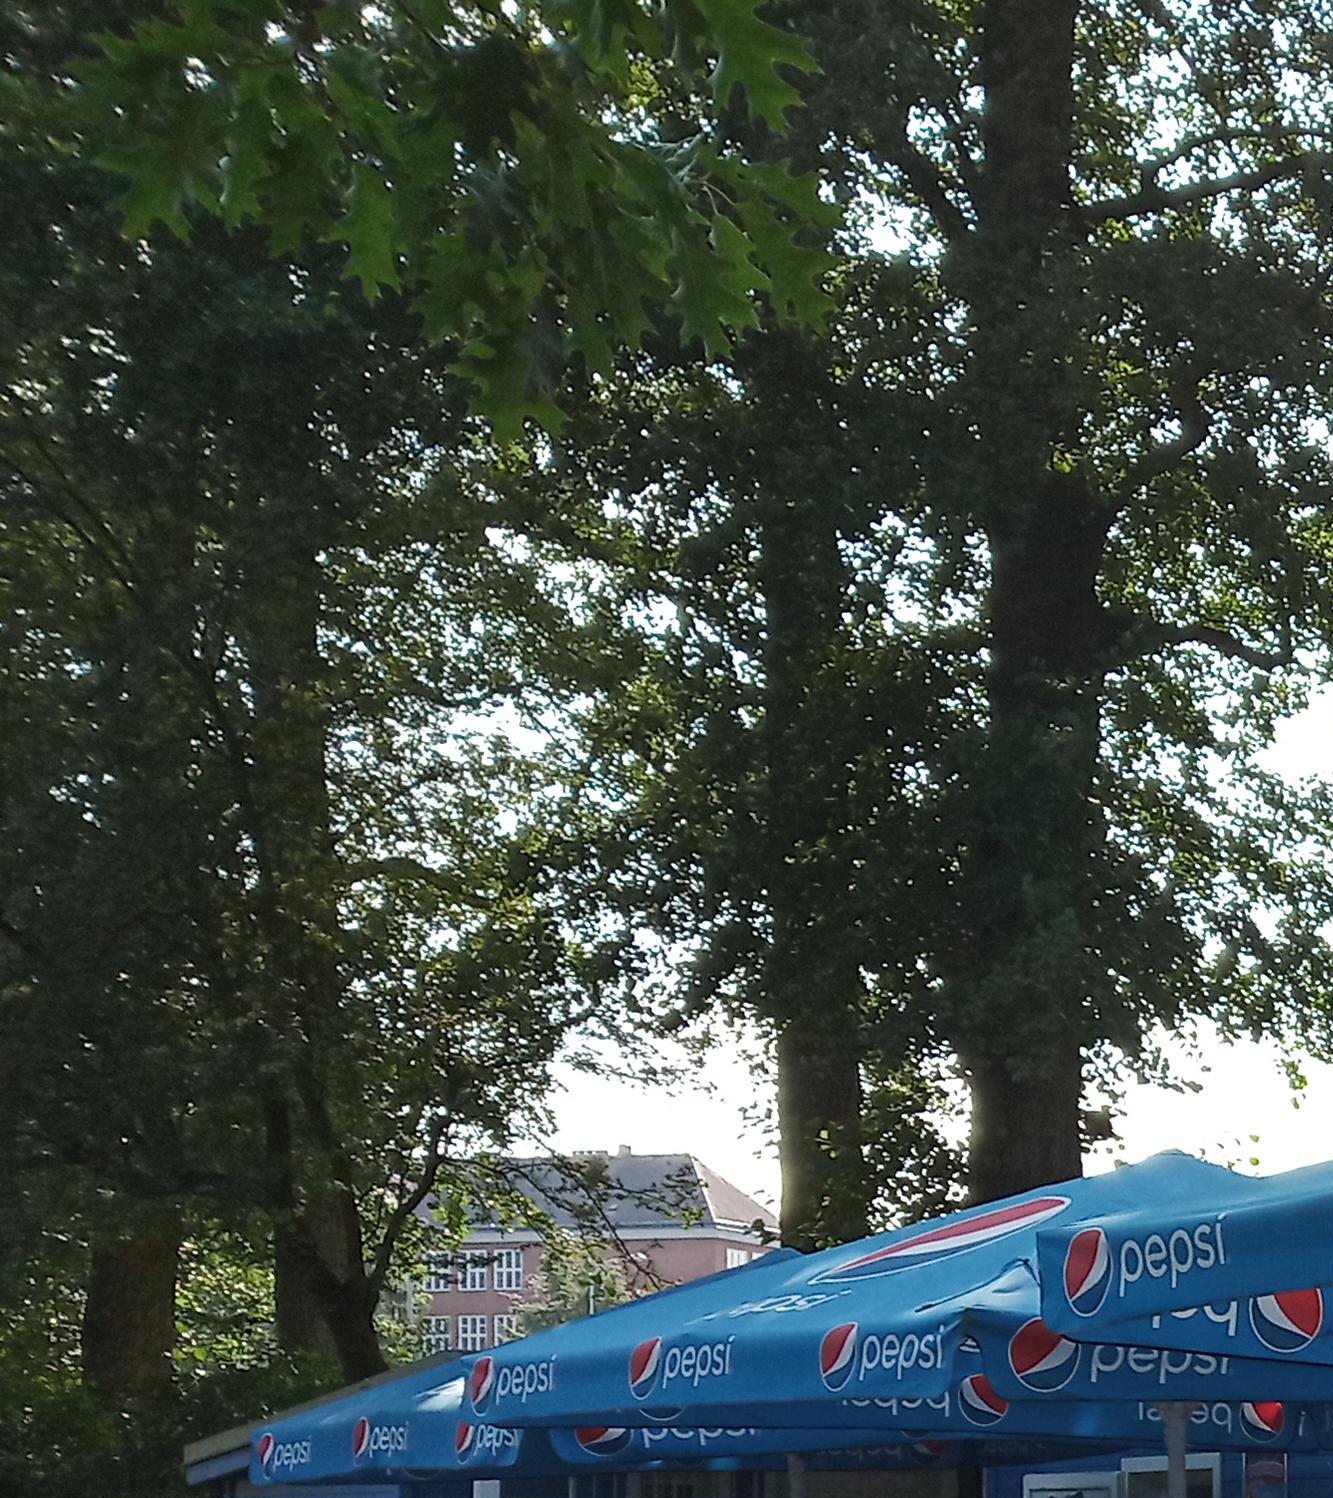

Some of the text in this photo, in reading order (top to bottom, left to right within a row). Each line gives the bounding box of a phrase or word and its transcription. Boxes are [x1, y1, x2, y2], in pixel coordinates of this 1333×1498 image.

[1118, 1213, 1228, 1299] pepsi
[662, 1335, 736, 1390] pepsi
[858, 1324, 946, 1382] pepsi
[493, 1354, 559, 1406] pepsi
[272, 1434, 312, 1473] pepsi
[368, 1420, 409, 1459] pepsi
